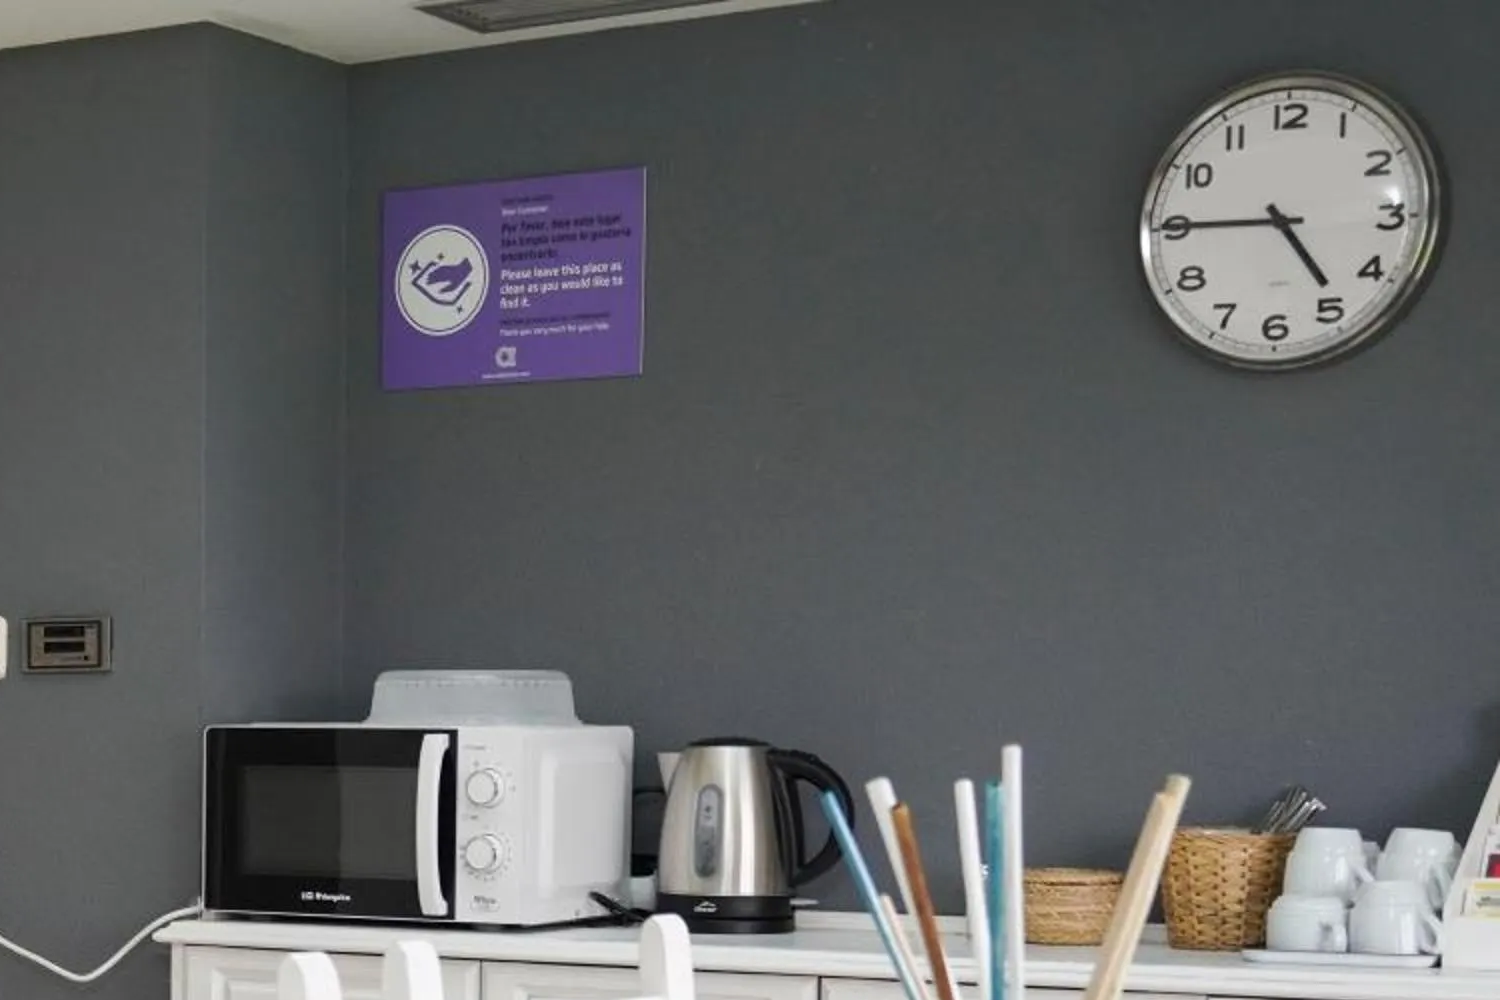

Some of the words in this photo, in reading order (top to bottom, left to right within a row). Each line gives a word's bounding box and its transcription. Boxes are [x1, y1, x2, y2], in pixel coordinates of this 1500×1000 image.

[1273, 103, 1309, 131] 12
[1339, 111, 1347, 139] 1
[1226, 124, 1245, 151] 11
[1185, 163, 1213, 190] 10
[1363, 150, 1392, 177] 2
[1161, 215, 1191, 240] 9
[1375, 202, 1405, 231] 3
[501, 268, 532, 281] Please
[533, 265, 560, 278] leave
[561, 262, 581, 276] this
[582, 261, 609, 276] place
[609, 261, 623, 272] as
[1177, 265, 1206, 291] 8
[1356, 255, 1384, 282] 4
[500, 282, 525, 295] clean
[527, 283, 538, 293] as
[540, 281, 559, 295] you
[561, 277, 590, 290] would
[591, 275, 611, 288] like
[611, 275, 623, 287] to
[500, 297, 518, 309] find
[1213, 303, 1237, 330] 7
[1315, 297, 1344, 324] 5
[1261, 314, 1289, 341] 6
